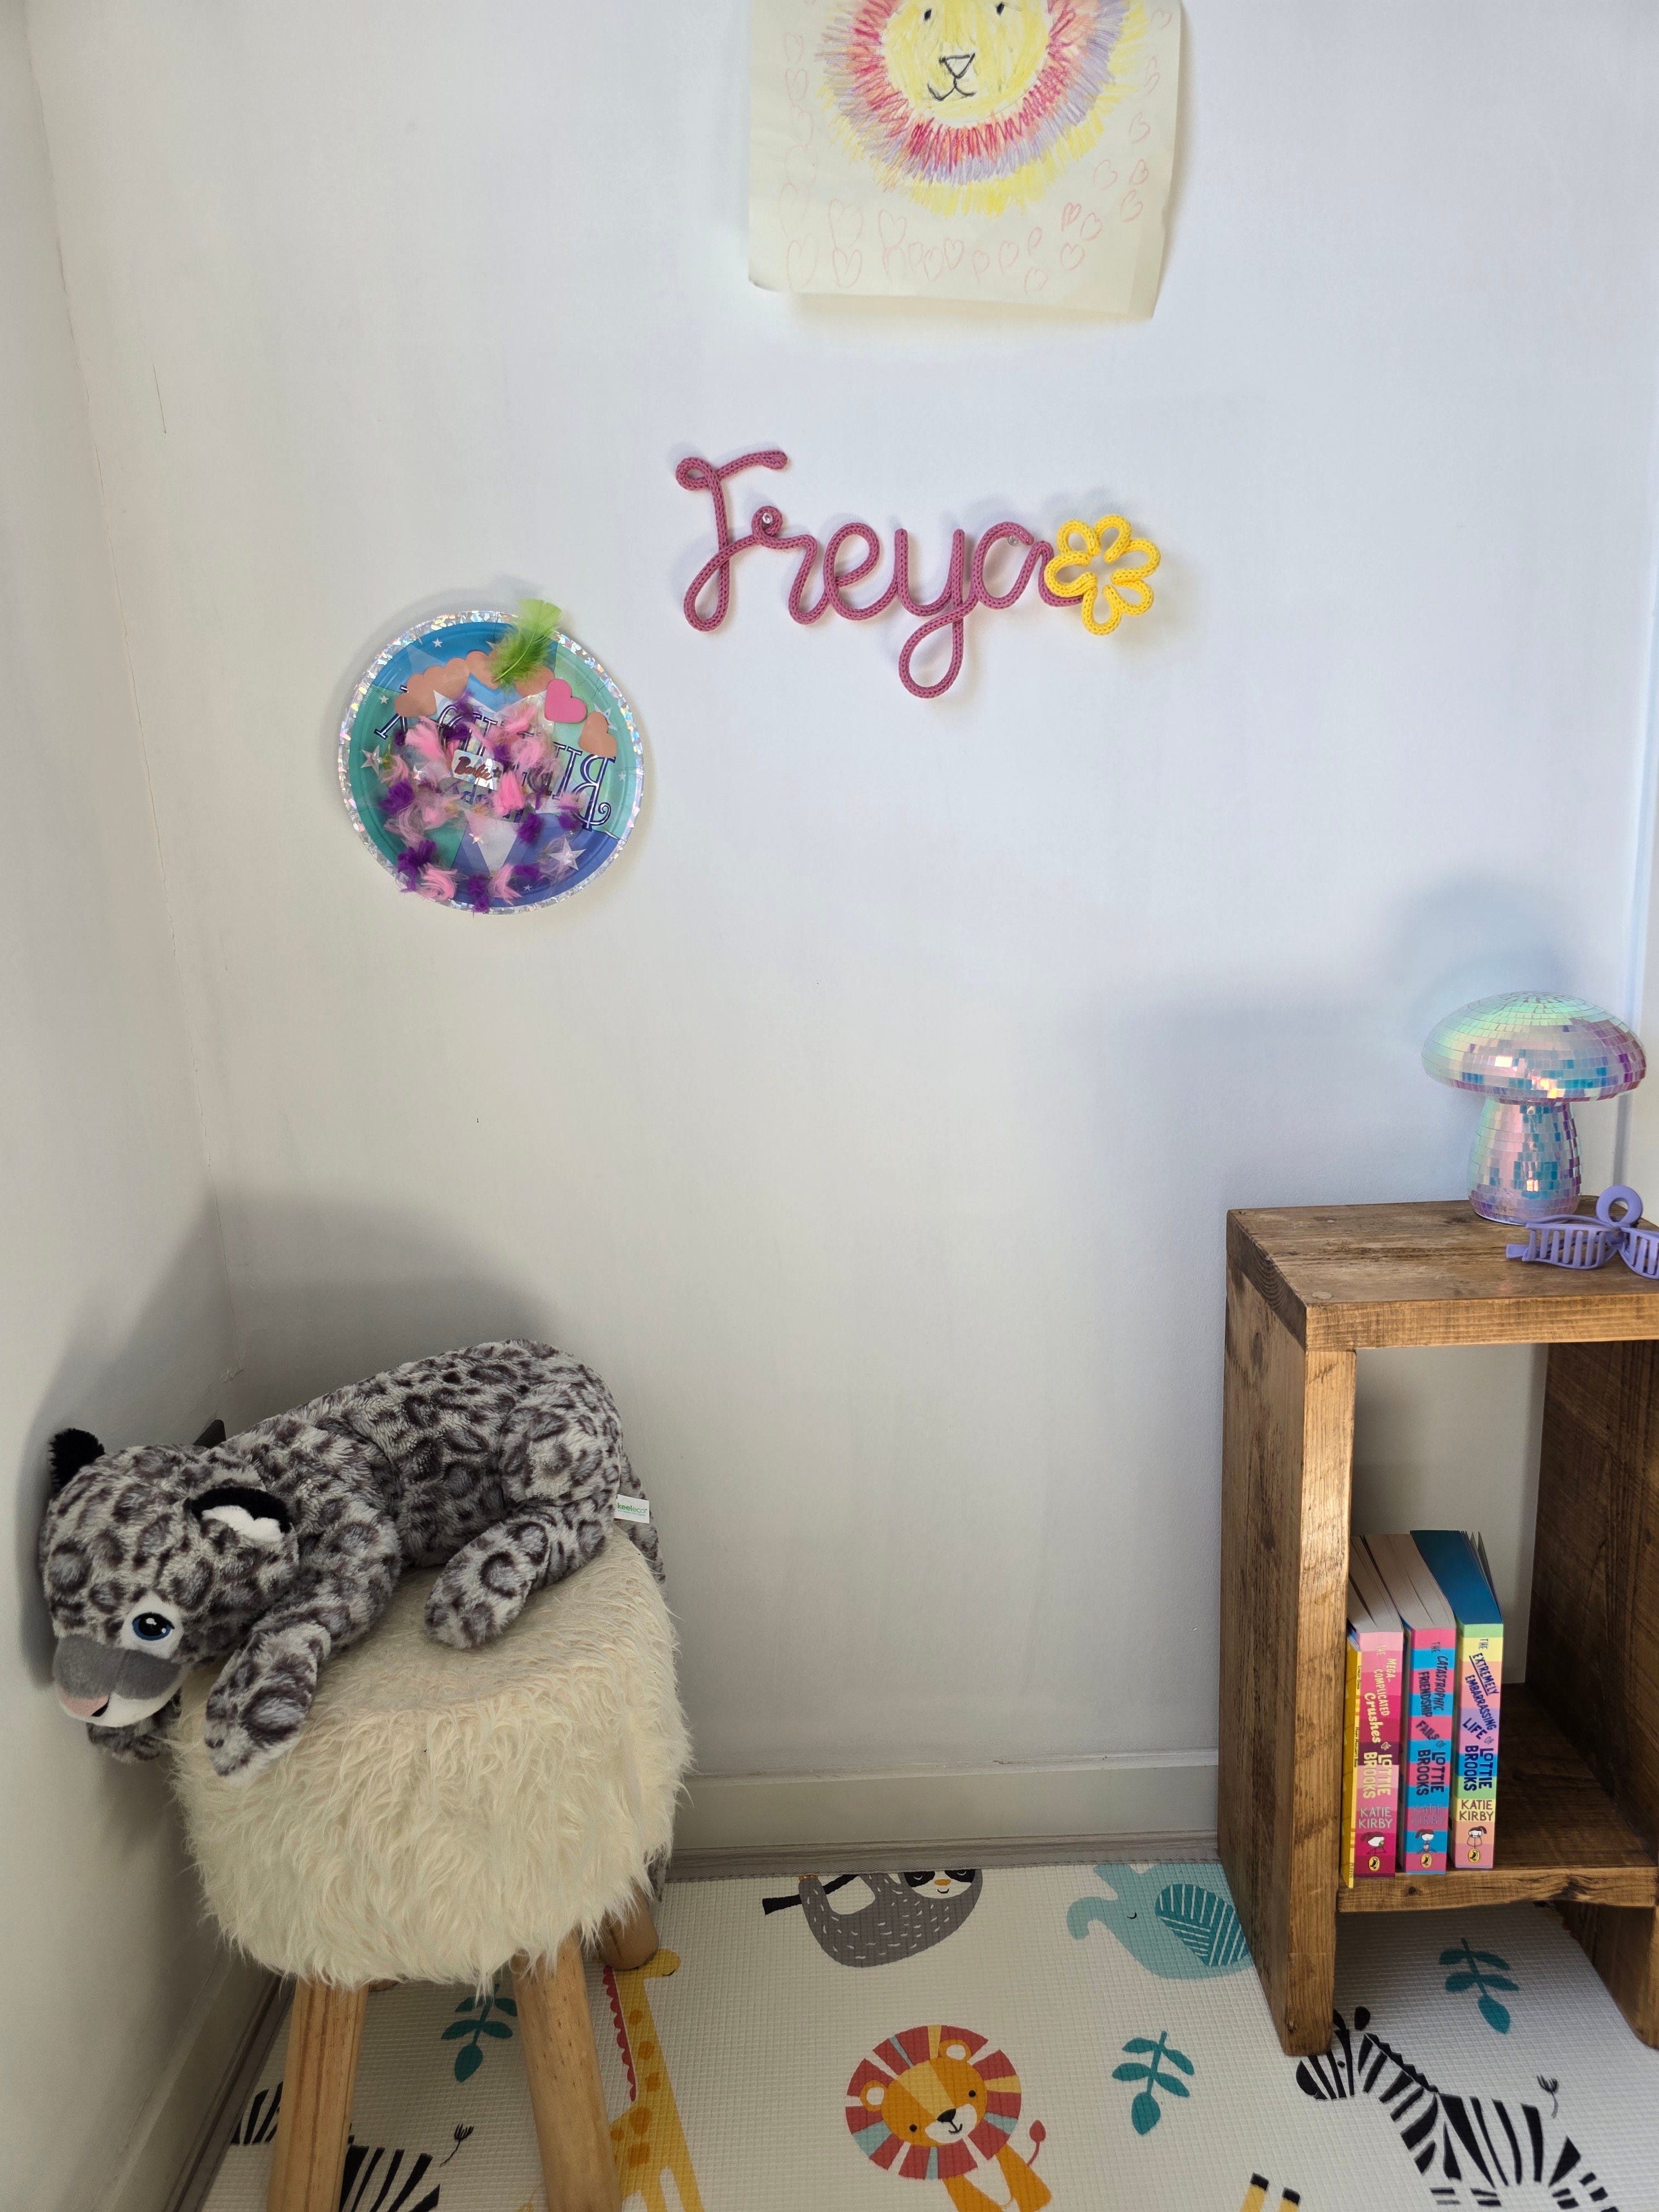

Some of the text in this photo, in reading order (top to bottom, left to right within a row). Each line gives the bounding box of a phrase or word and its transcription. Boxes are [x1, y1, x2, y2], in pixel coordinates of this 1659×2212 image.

[675, 449, 1084, 699] Freya
[455, 756, 493, 781] Barbie
[1431, 1641, 1441, 1653] THE
[1478, 1638, 1489, 1650] THE
[1386, 1658, 1397, 1683] MEGA-
[1433, 1656, 1448, 1712] CATASTROPHIC
[1472, 1653, 1499, 1695] EXTREMELY
[1373, 1668, 1390, 1715] COMPLICATED
[1418, 1672, 1433, 1718] FRIENDSHIP
[1465, 1674, 1496, 1730] EMBARRASSING
[1364, 1692, 1383, 1744] Crushes
[1416, 1720, 1440, 1740] FAILS
[1463, 1718, 1487, 1740] LIFE
[1363, 1752, 1378, 1799] BROOKS
[1377, 1754, 1392, 1796] LOTTIE
[1416, 1750, 1431, 1796] BROOKS
[1431, 1752, 1446, 1793] LOTTIE
[1464, 1745, 1478, 1791] BROOKS
[1479, 1748, 1493, 1789] LOTTIE
[1359, 1818, 1393, 1829] KIRBY
[1360, 1807, 1392, 1817] KATIE
[1412, 1815, 1444, 1825] KIRBY
[1413, 1804, 1442, 1814] KATIE
[1459, 1811, 1494, 1821] KIRBY
[1461, 1799, 1493, 1810] KATIE
